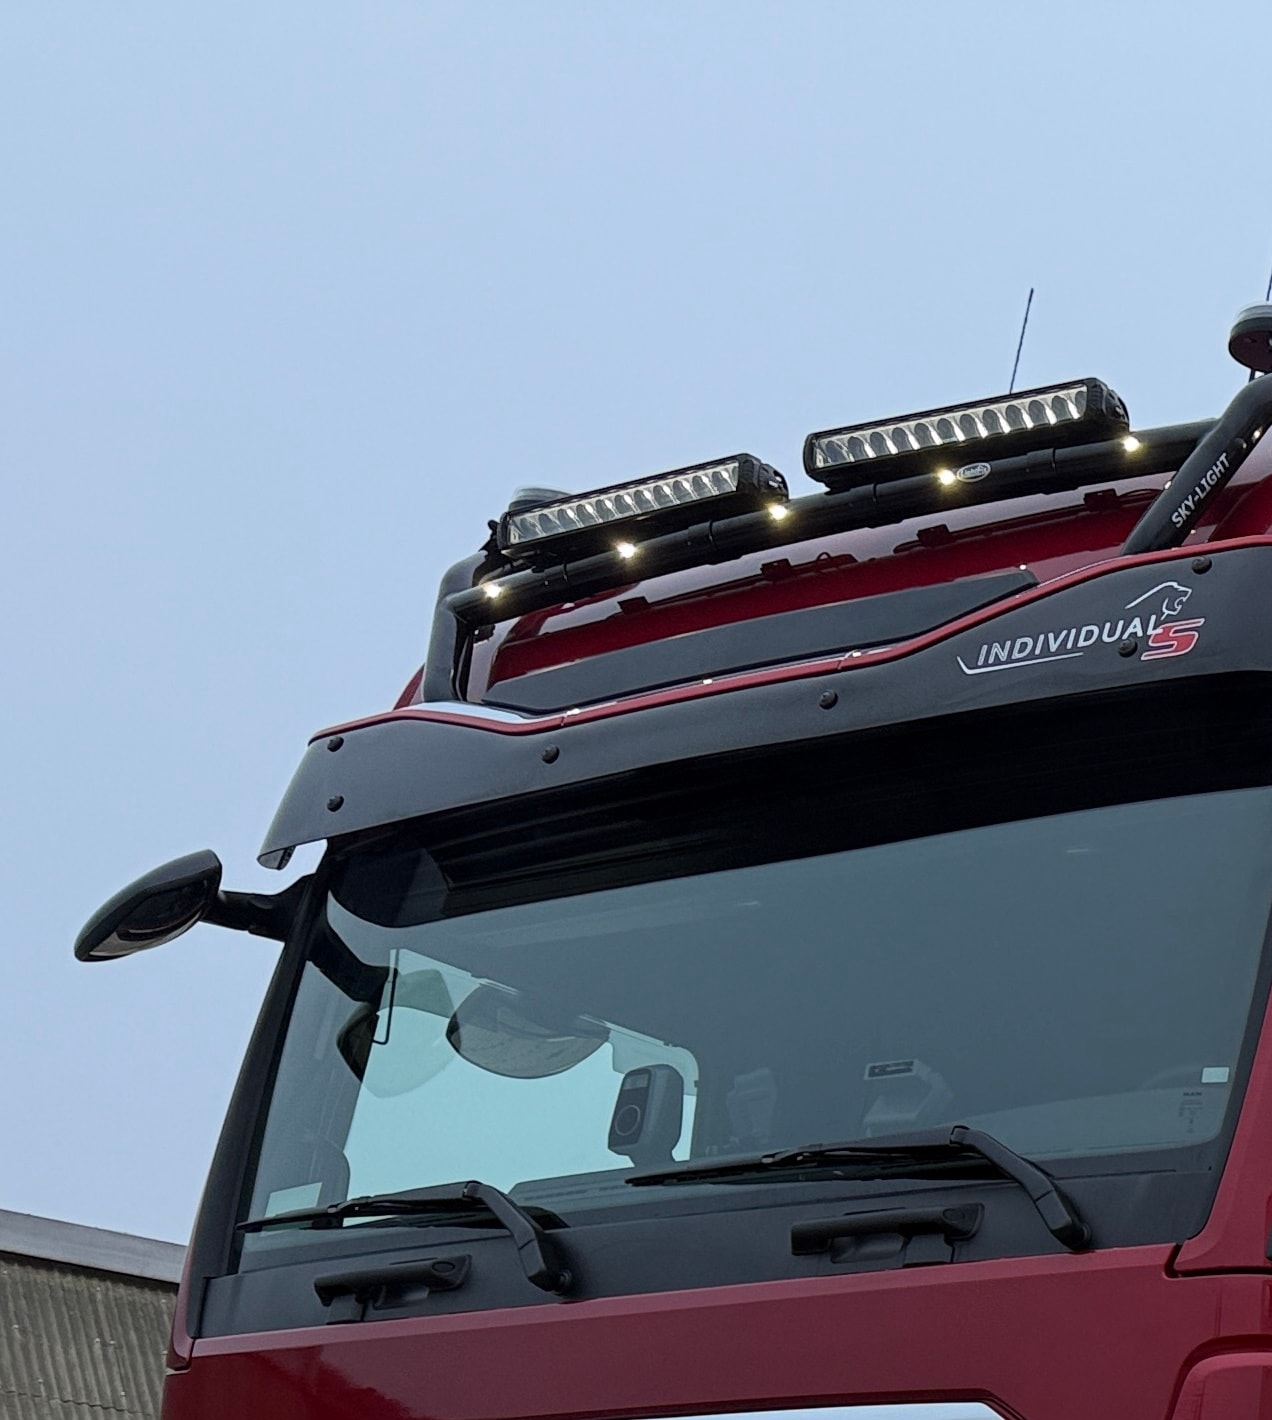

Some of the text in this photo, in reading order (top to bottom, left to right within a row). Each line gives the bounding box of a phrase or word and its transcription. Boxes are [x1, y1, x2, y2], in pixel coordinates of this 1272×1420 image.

[1171, 452, 1230, 528] SKY-LIGHT
[977, 614, 1206, 666] INDIVIDUAL S
